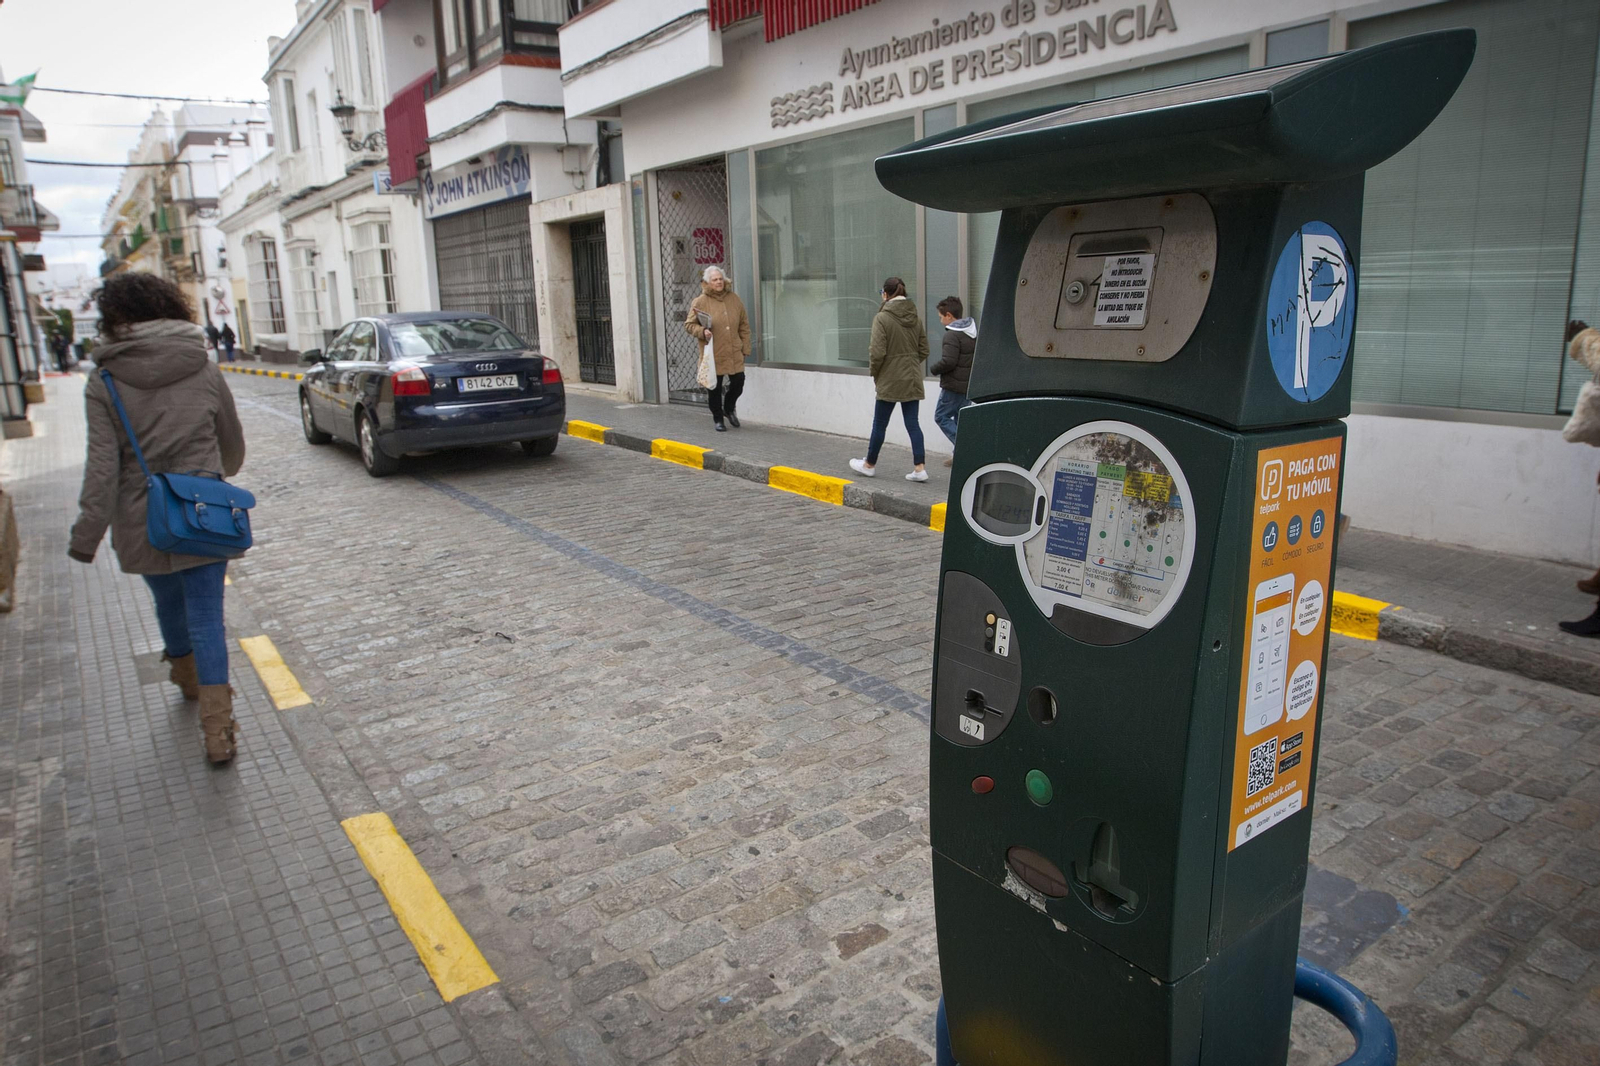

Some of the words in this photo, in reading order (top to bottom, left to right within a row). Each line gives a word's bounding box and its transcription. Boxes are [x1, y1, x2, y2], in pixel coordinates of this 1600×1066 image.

[838, 11, 995, 80] Ayuntamiento
[1000, 0, 1036, 28] de
[840, 72, 904, 113] AREA
[909, 59, 945, 96] DE
[952, 0, 1178, 85] PRESIDENCIA
[435, 177, 465, 206] JOHN
[467, 153, 531, 197] ATKINSON
[1117, 257, 1126, 265] POR
[1118, 268, 1143, 276] INTRODUCIR
[1132, 278, 1147, 286] BUZÓN
[1123, 291, 1130, 299] NO
[1129, 290, 1145, 299] PIERDA
[1103, 304, 1116, 312] MITAD
[1115, 303, 1124, 311] DEL
[1124, 303, 1137, 312] TIQUE
[1136, 303, 1143, 311] DE
[1106, 314, 1130, 323] ANULACIÓN
[466, 378, 493, 389] 8142
[495, 376, 515, 387] CKZ
[1288, 457, 1314, 478] PAGA
[1316, 453, 1336, 472] CON
[1286, 484, 1300, 502] TU
[1301, 475, 1332, 498] MÓVIL
[1259, 500, 1281, 516] telpark
[1261, 556, 1274, 568] FÁCIL
[1282, 547, 1302, 562] CÓMODO
[1306, 541, 1325, 555] SEGURO
[1293, 672, 1309, 685] Escanea
[1303, 680, 1311, 689] QR
[1244, 779, 1297, 815] www.telpark.com
